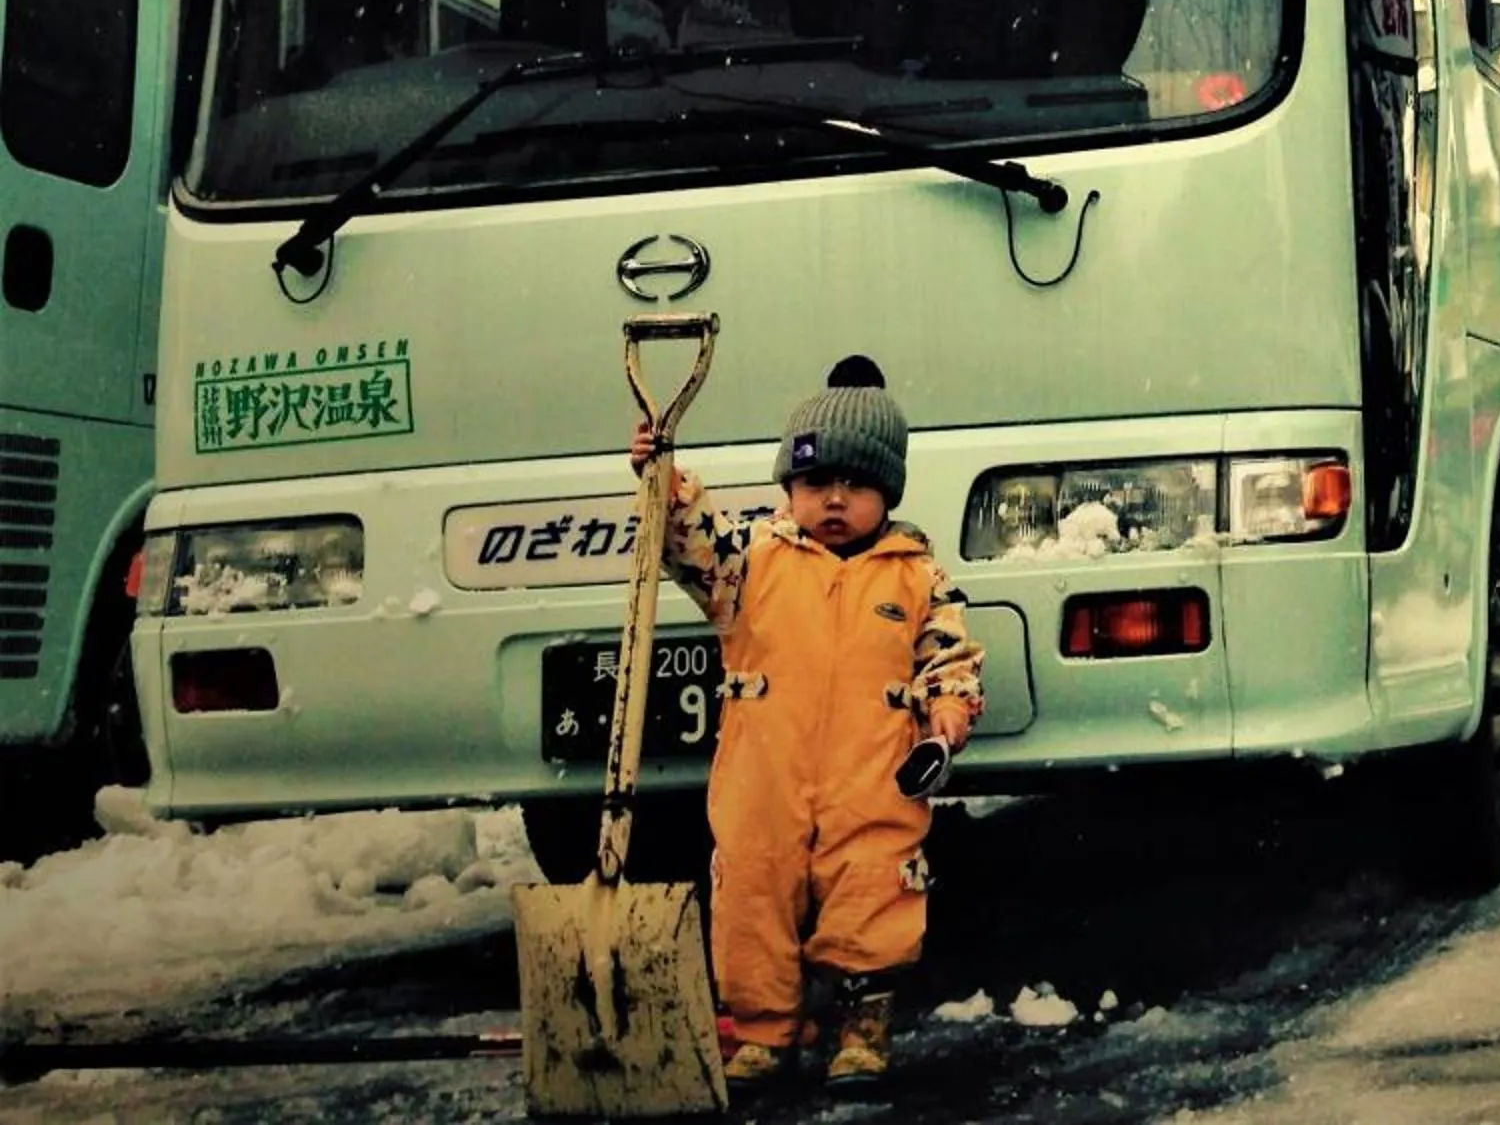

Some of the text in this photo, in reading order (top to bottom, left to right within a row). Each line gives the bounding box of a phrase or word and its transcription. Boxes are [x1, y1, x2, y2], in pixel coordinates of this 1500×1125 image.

[195, 339, 409, 378] NOZAWA ONSEN
[226, 368, 402, 441] 野沢温泉
[655, 645, 708, 679] 200
[555, 683, 707, 744] あ 9
